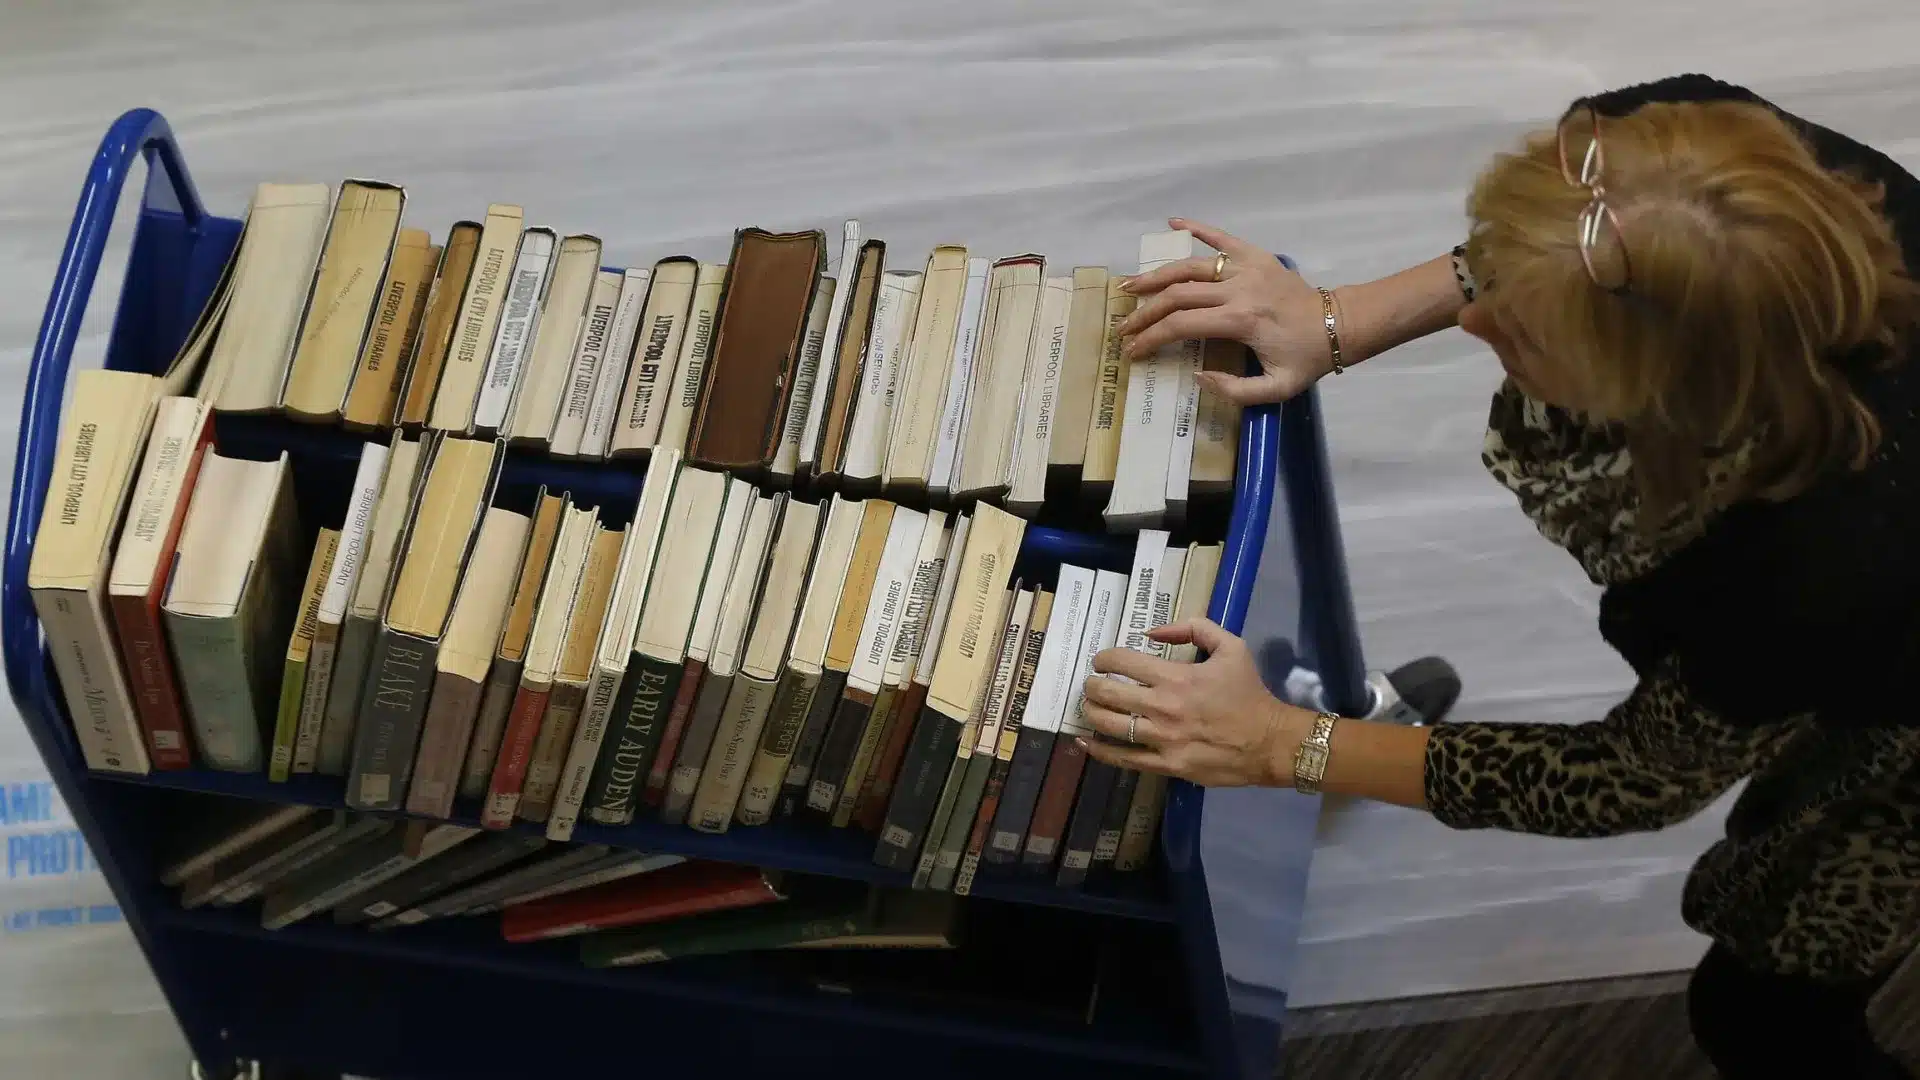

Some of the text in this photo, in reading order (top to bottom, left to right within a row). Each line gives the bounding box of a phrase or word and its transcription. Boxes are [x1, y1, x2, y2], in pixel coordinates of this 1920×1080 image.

[367, 280, 405, 371] LIVERPOOL LIBRARIES
[456, 247, 503, 363] LIVERPOOL CITY LIBRARIES
[583, 305, 611, 352] LIVERPOOL
[643, 315, 673, 361] LIVERPOOL
[681, 309, 712, 408] LIVERPOOL LIBRARIES
[799, 330, 824, 377] LIVERPOOL
[578, 353, 597, 373] CITY
[638, 364, 659, 382] CITY
[1036, 326, 1063, 439] LIVERPOOL LIBRARIES
[1103, 365, 1119, 383] CITY
[794, 380, 812, 400] CITY
[1141, 370, 1154, 424] LIBRARIES
[60, 422, 97, 524] LIVERPOOL CITY LIBRARIES
[335, 487, 374, 585] LIVERPOOL LIBRARIES
[910, 559, 933, 600] LIBRARIES
[1134, 567, 1153, 609] LIBRARIES
[297, 599, 321, 640] LIVERPOOL
[868, 579, 901, 664] LIVERPOOL LIBRARIES
[904, 600, 923, 618] CITY
[958, 615, 983, 658] LIVERPOOL
[976, 552, 995, 593] LIBRARIES
[1130, 610, 1146, 629] CITY
[890, 620, 920, 662] LIVERPOOL
[373, 645, 424, 712] BLAKE
[592, 675, 615, 709] POETRY
[984, 683, 1005, 726] LIVERPOOL
[1000, 623, 1020, 663] LIBRARIES
[1004, 691, 1028, 731] LIVERPOOL
[1016, 670, 1033, 689] CITY
[600, 668, 667, 814] EARLY AUDEN
[775, 727, 794, 751] POET
